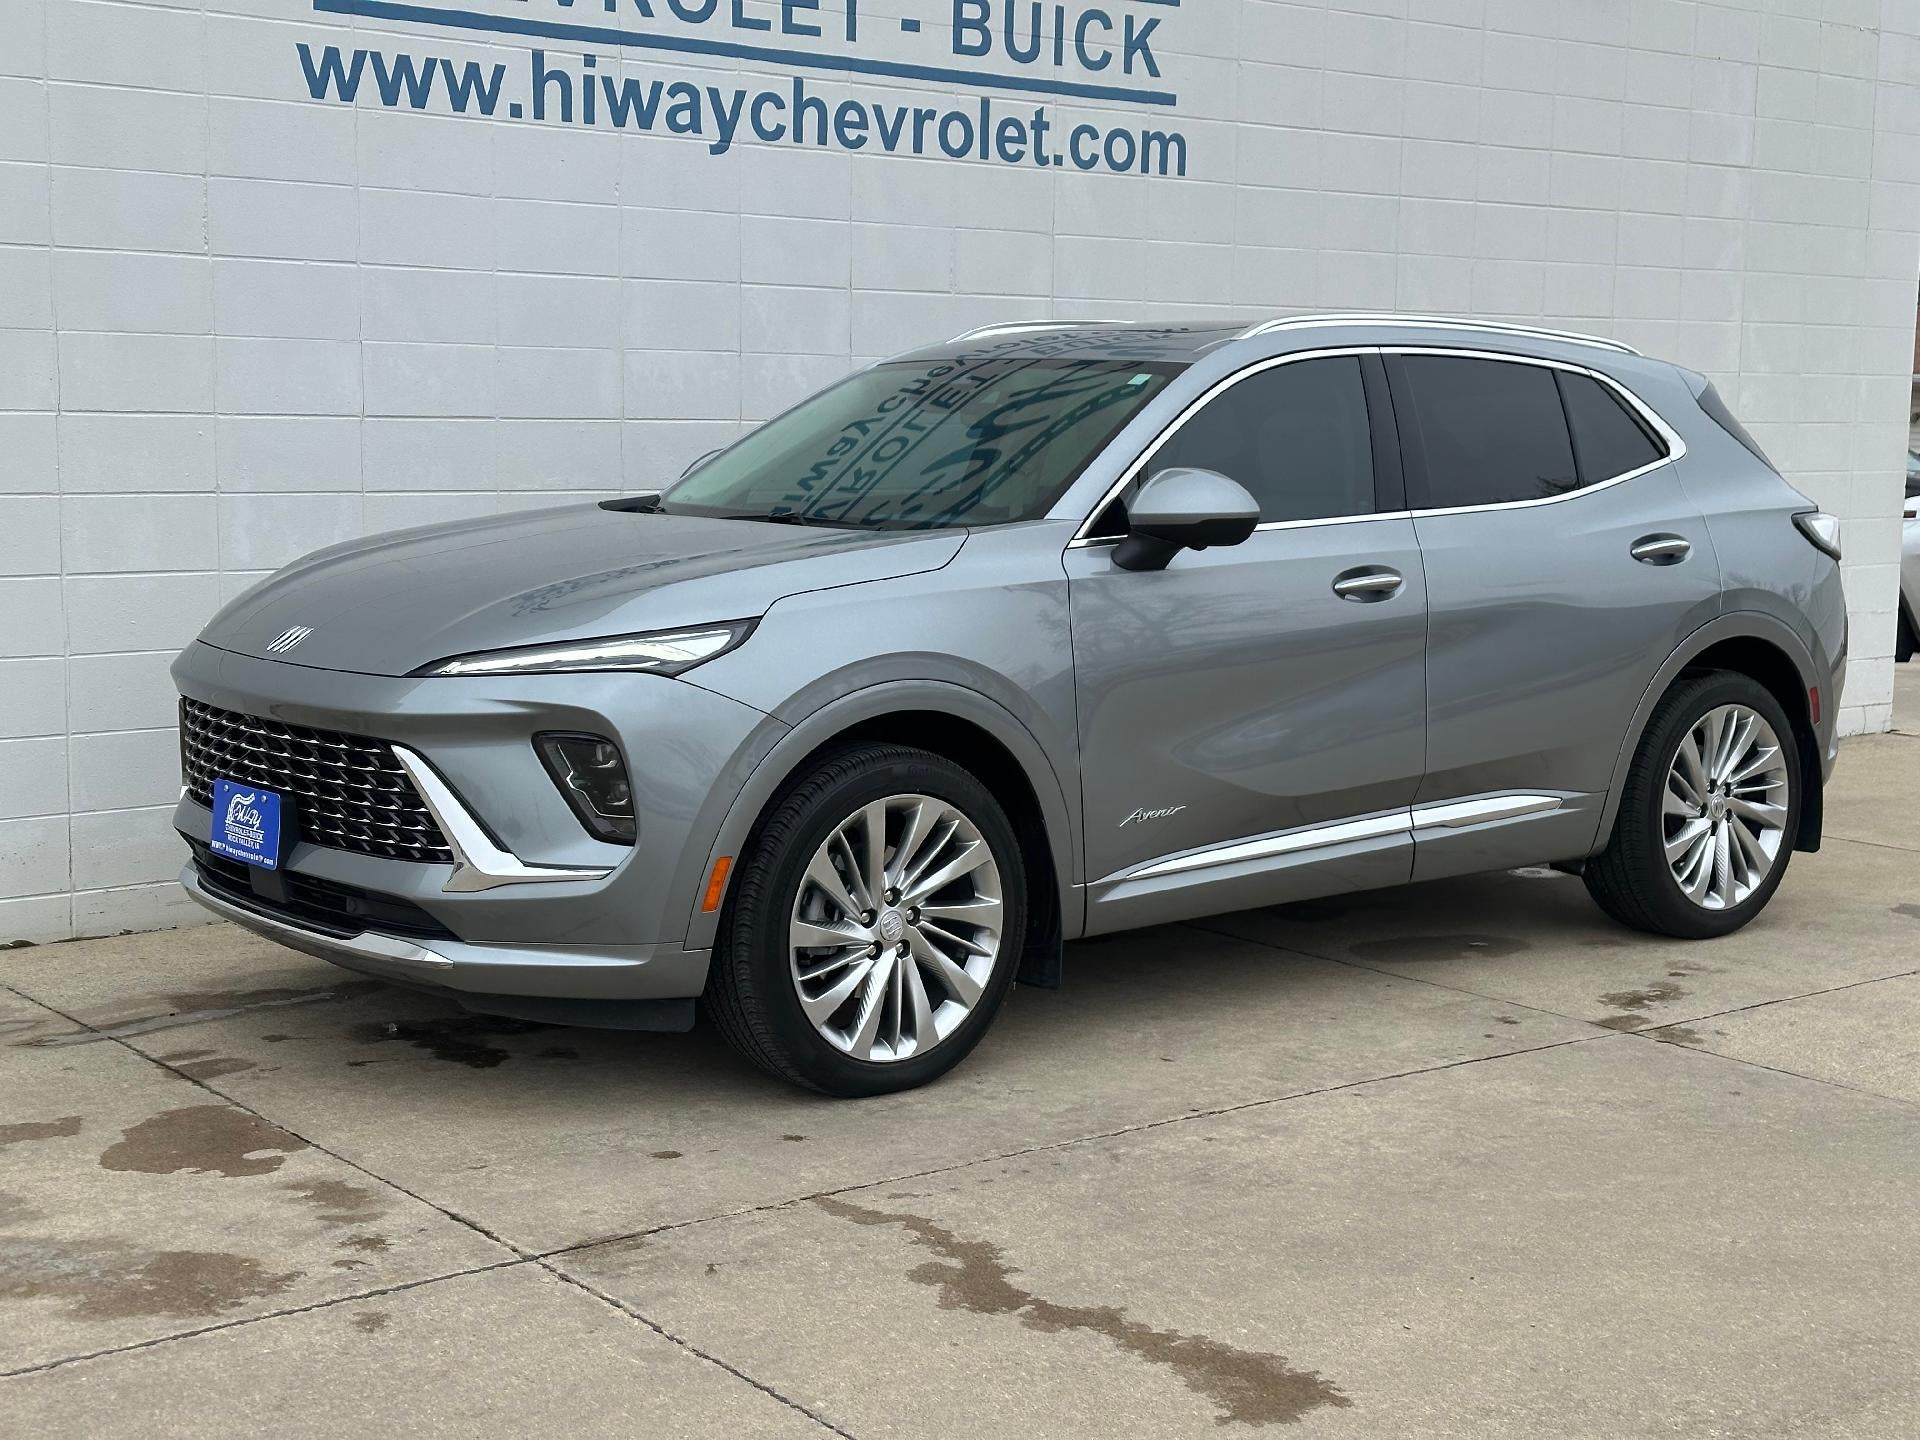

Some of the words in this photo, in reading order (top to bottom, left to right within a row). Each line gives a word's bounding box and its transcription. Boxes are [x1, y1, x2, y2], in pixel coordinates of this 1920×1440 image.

[952, 0, 1162, 78] BUICK
[295, 42, 1187, 177] www.hiwaychevrolet.com
[1119, 805, 1187, 828] Avenir
